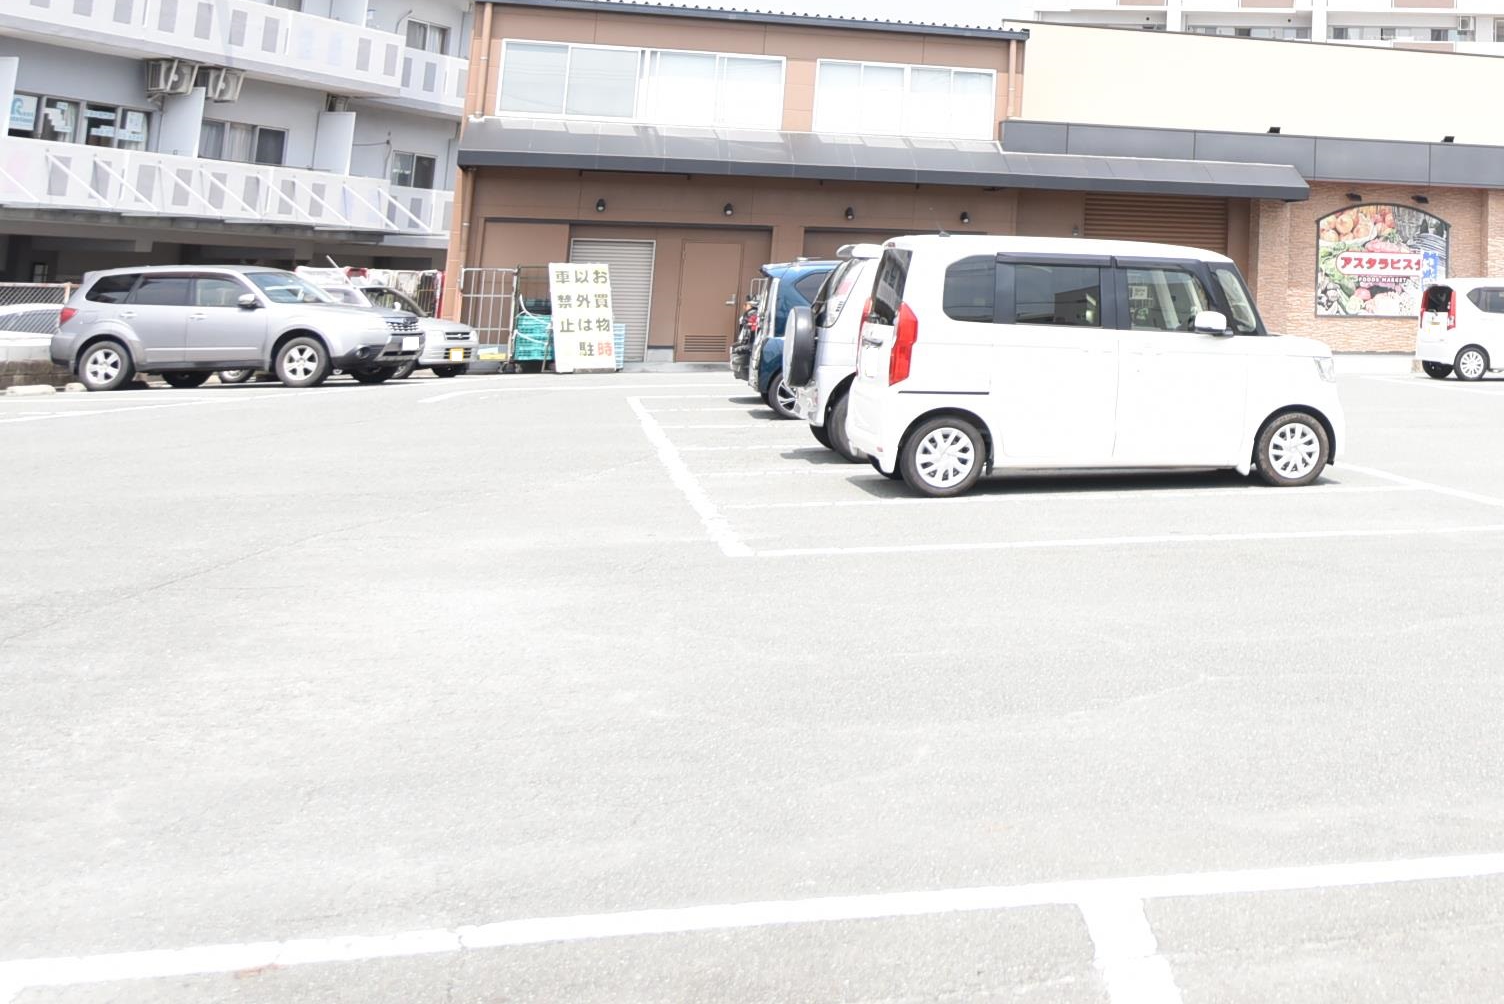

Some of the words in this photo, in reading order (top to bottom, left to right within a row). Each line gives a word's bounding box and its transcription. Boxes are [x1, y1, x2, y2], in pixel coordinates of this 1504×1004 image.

[555, 270, 575, 333] 車禁止
[574, 269, 595, 357] 以外は駐
[592, 269, 613, 357] お買物時
